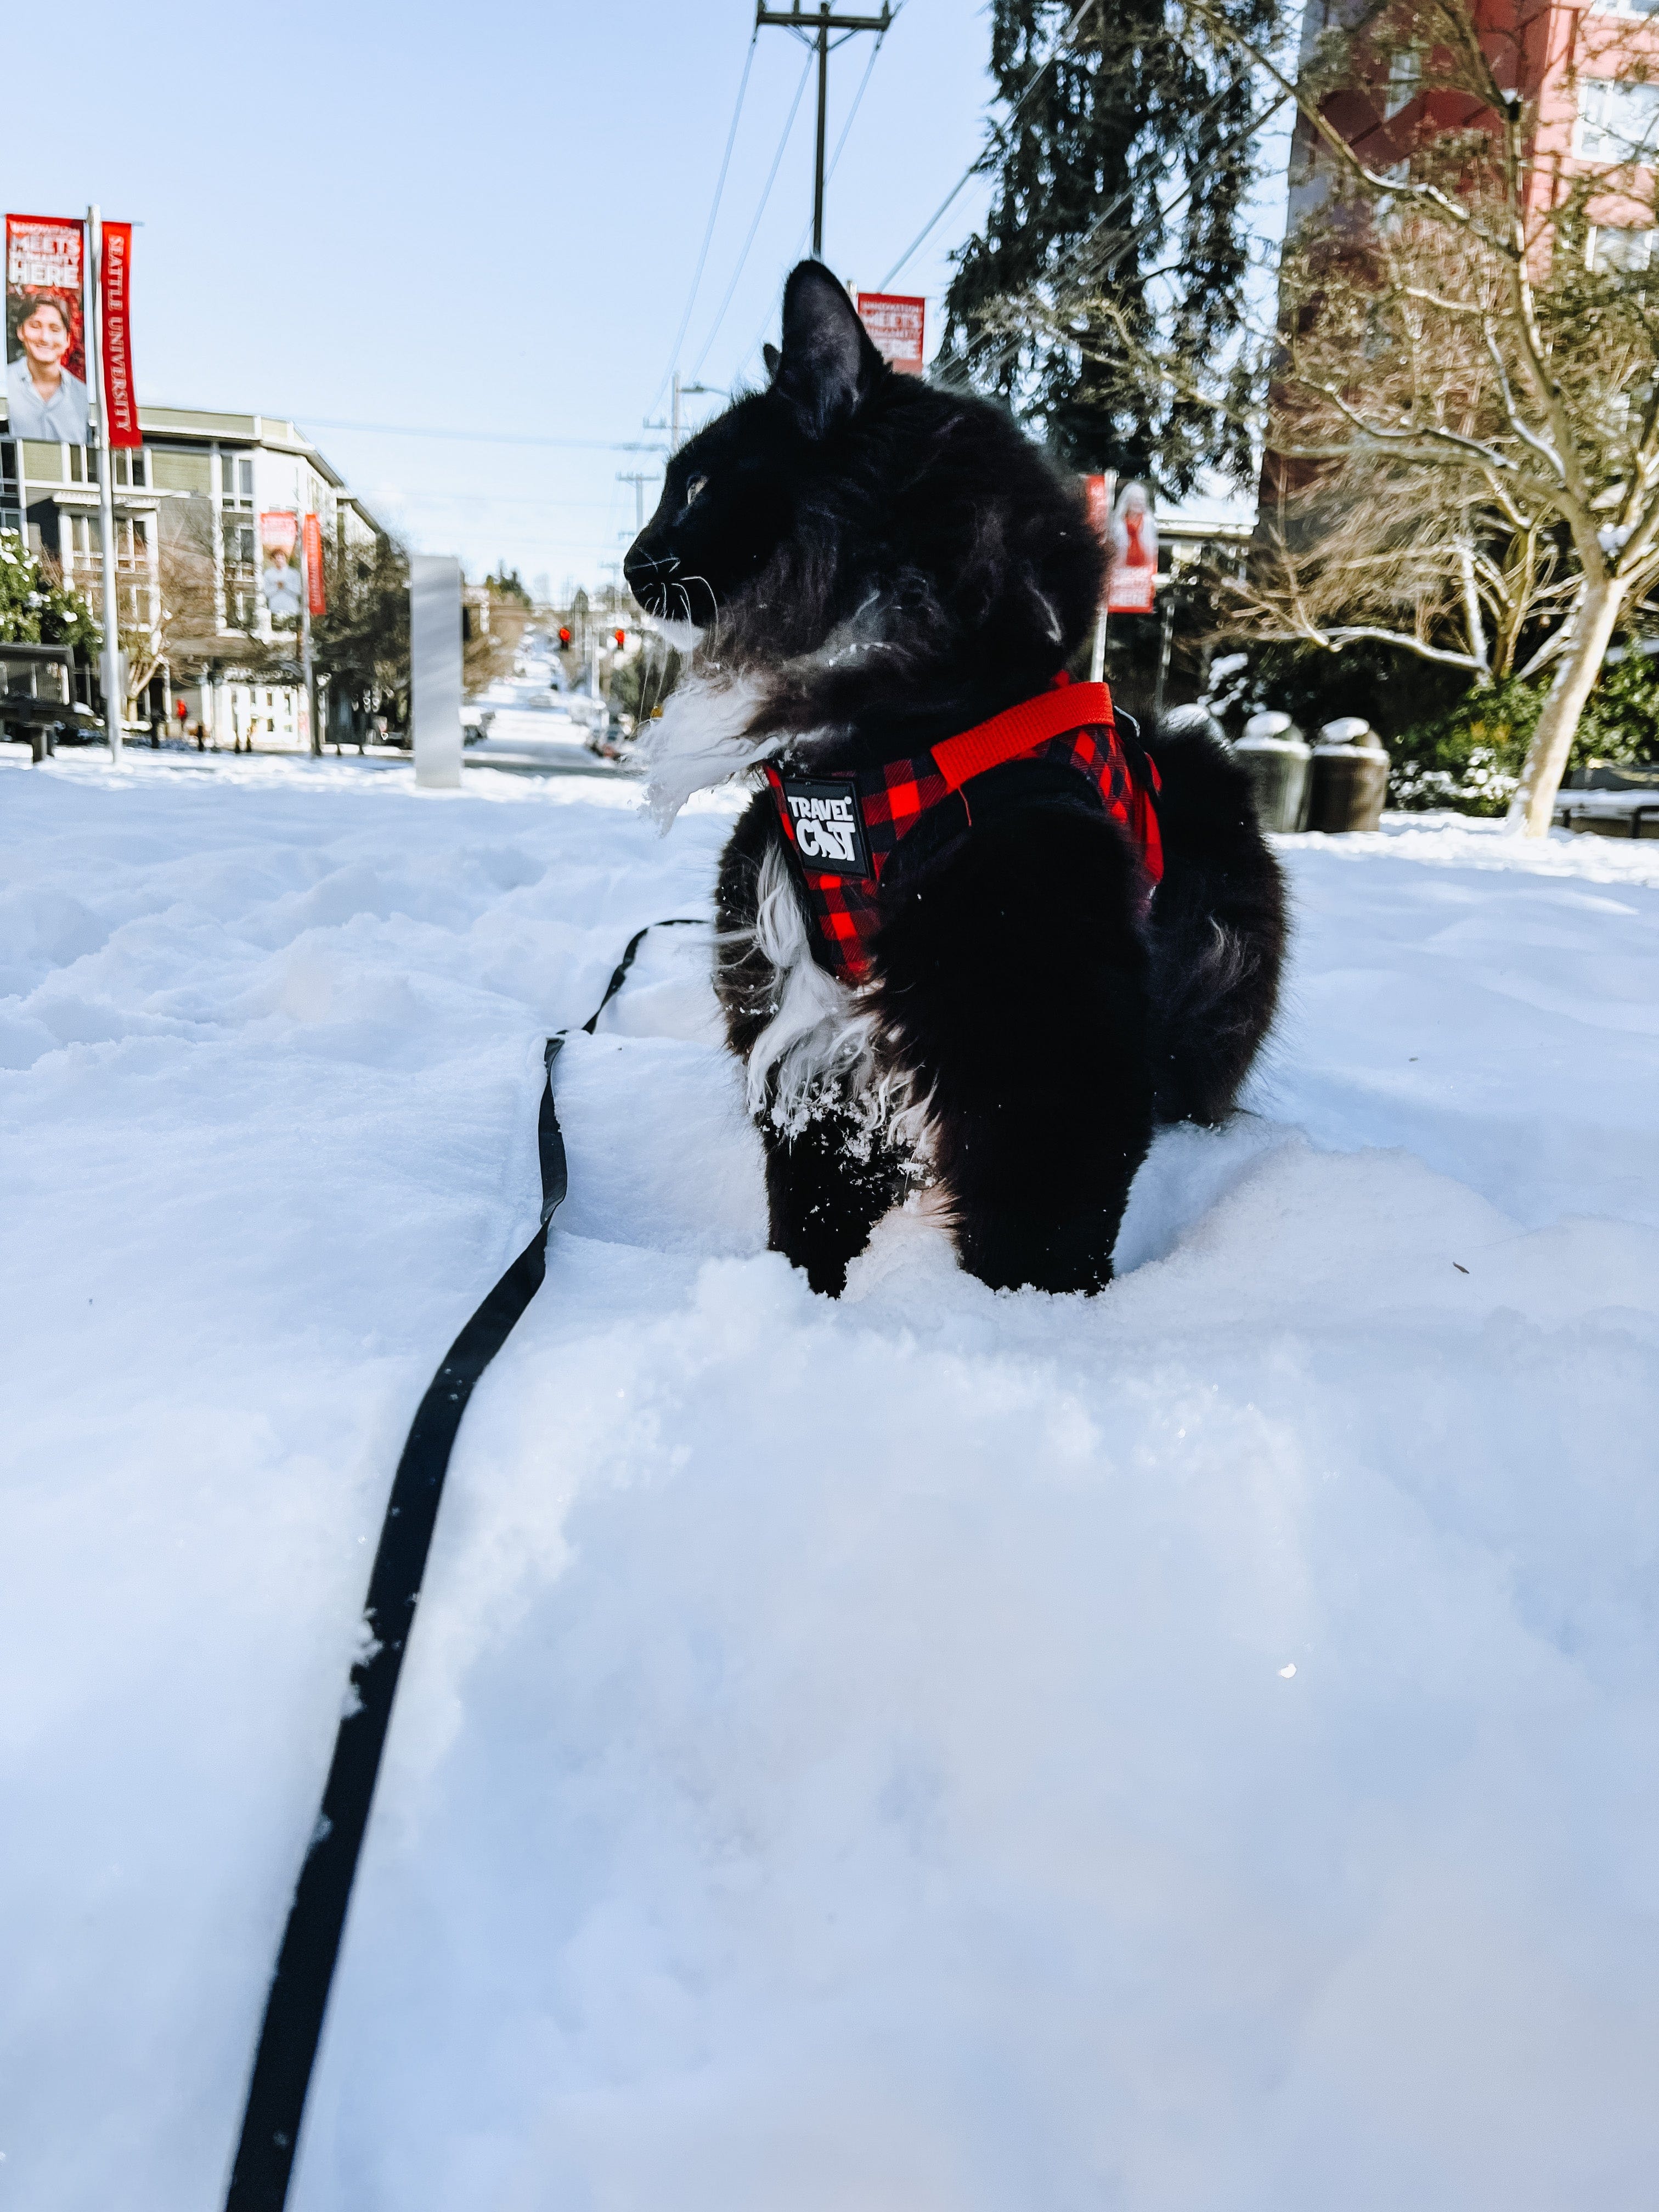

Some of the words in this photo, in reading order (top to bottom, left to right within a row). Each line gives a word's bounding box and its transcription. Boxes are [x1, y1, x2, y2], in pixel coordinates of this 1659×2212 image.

[11, 234, 80, 256] MEETS
[9, 261, 79, 289] HERE
[108, 234, 125, 311] SEATTLE
[108, 317, 131, 432] UNIVERSITY
[787, 796, 854, 821] TRAVEL
[796, 818, 856, 861] CAT
